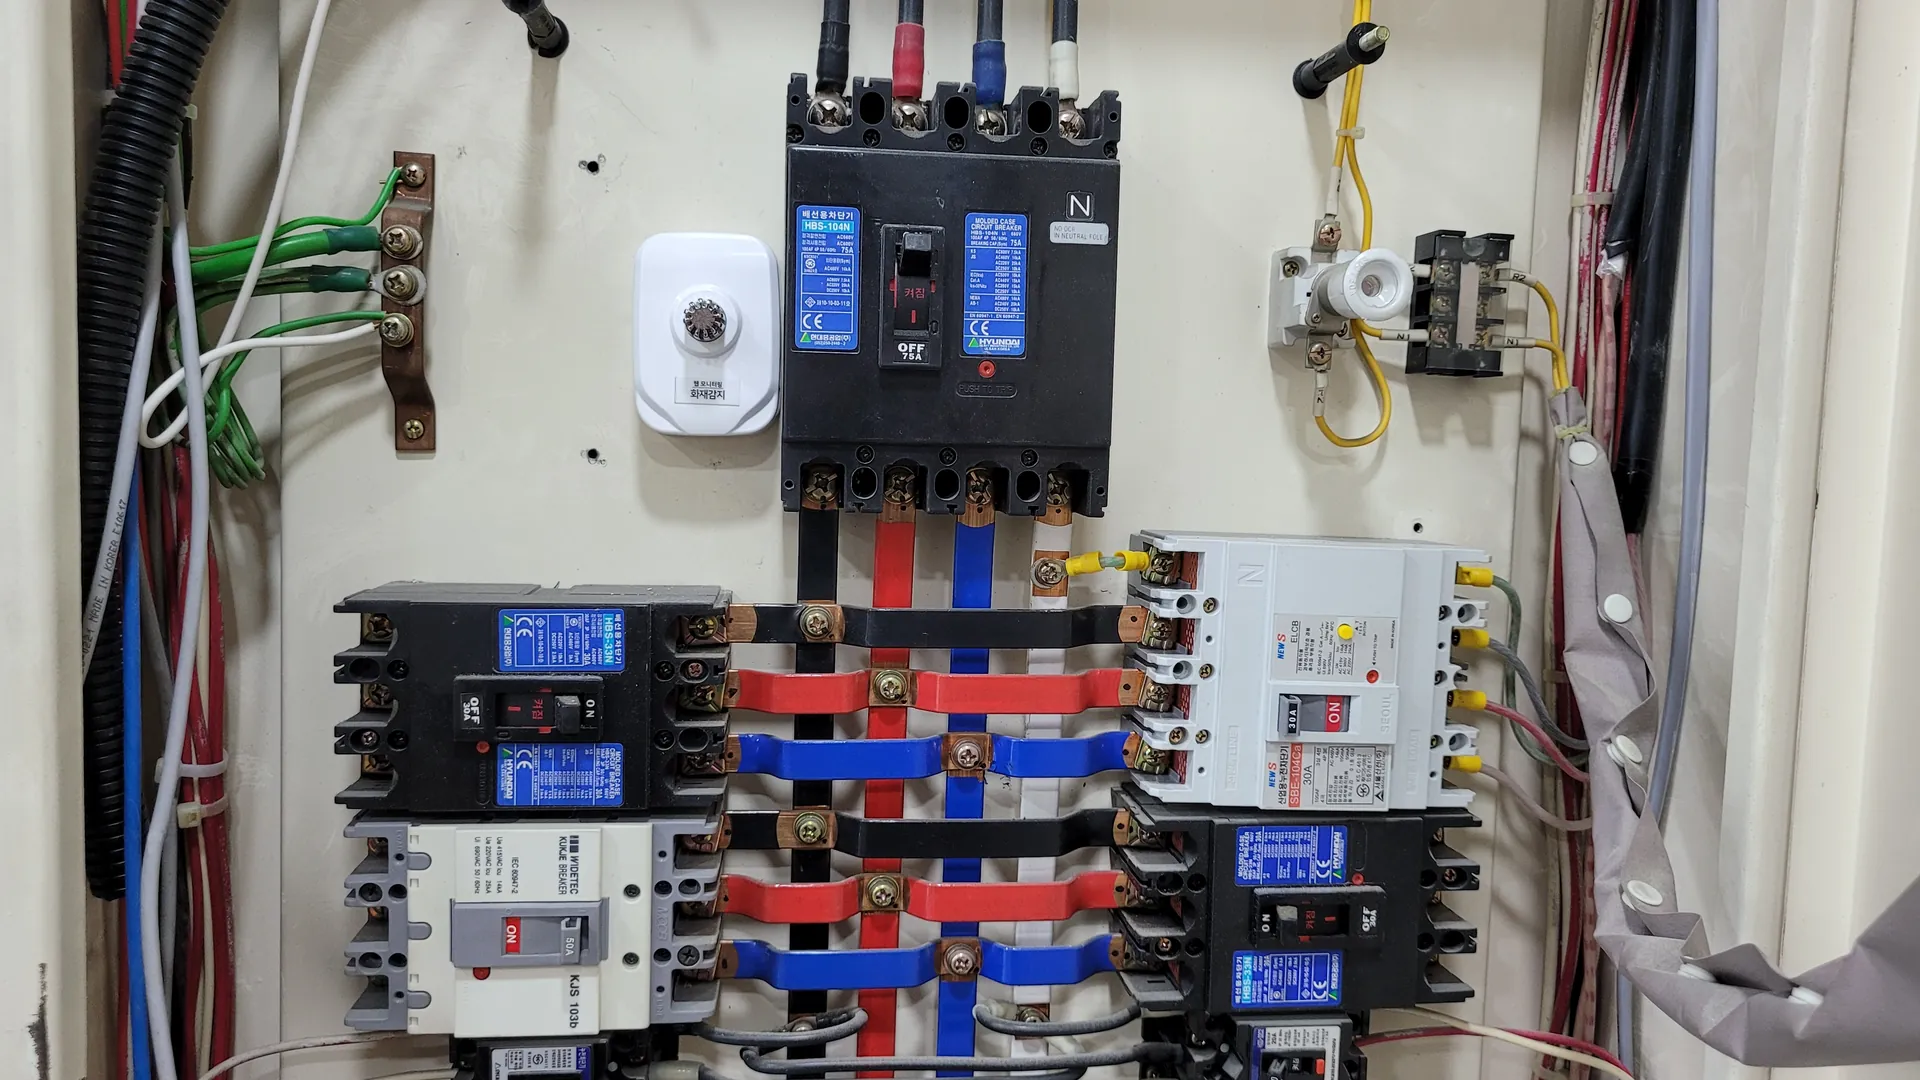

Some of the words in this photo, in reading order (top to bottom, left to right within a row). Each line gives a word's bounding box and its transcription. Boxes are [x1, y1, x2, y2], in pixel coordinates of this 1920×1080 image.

[802, 210, 853, 220] 배선용차단기
[1071, 195, 1090, 216] N
[805, 222, 850, 231] HBS-104N
[904, 288, 925, 299] 켜짐
[802, 313, 822, 329] CE
[970, 320, 989, 336] CE
[898, 343, 925, 352] OFF
[690, 389, 725, 400] 화재감지
[88, 595, 104, 623] MADE
[98, 576, 110, 589] IN
[105, 540, 119, 571] KOREA
[517, 617, 532, 637] CE
[605, 617, 613, 663] HBS-33N
[470, 697, 480, 725] OFF
[532, 699, 543, 719] 켜짐
[586, 699, 595, 718] ON
[1289, 709, 1297, 728] 30A
[1329, 702, 1340, 724] ON
[1380, 693, 1392, 733] SEOUL
[516, 749, 532, 769] CE
[1278, 746, 1289, 804] 산업용누전차단기
[1290, 745, 1301, 804] SBE-104Ca
[1303, 765, 1312, 785] 30A
[559, 836, 567, 861] KUKJE
[570, 856, 579, 894] WIDETEC
[1317, 860, 1330, 878] CE
[558, 864, 567, 895] BREAKER
[1262, 914, 1270, 932] ON
[1305, 910, 1315, 929] 켜짐
[1362, 906, 1371, 932] OFF
[1369, 909, 1377, 928] 30A
[506, 925, 516, 944] ON
[565, 938, 574, 956] 50A
[570, 974, 580, 997] KJS
[1243, 956, 1251, 1000] HBS-33N
[1313, 981, 1327, 999] CE
[569, 1002, 579, 1028] 103b
